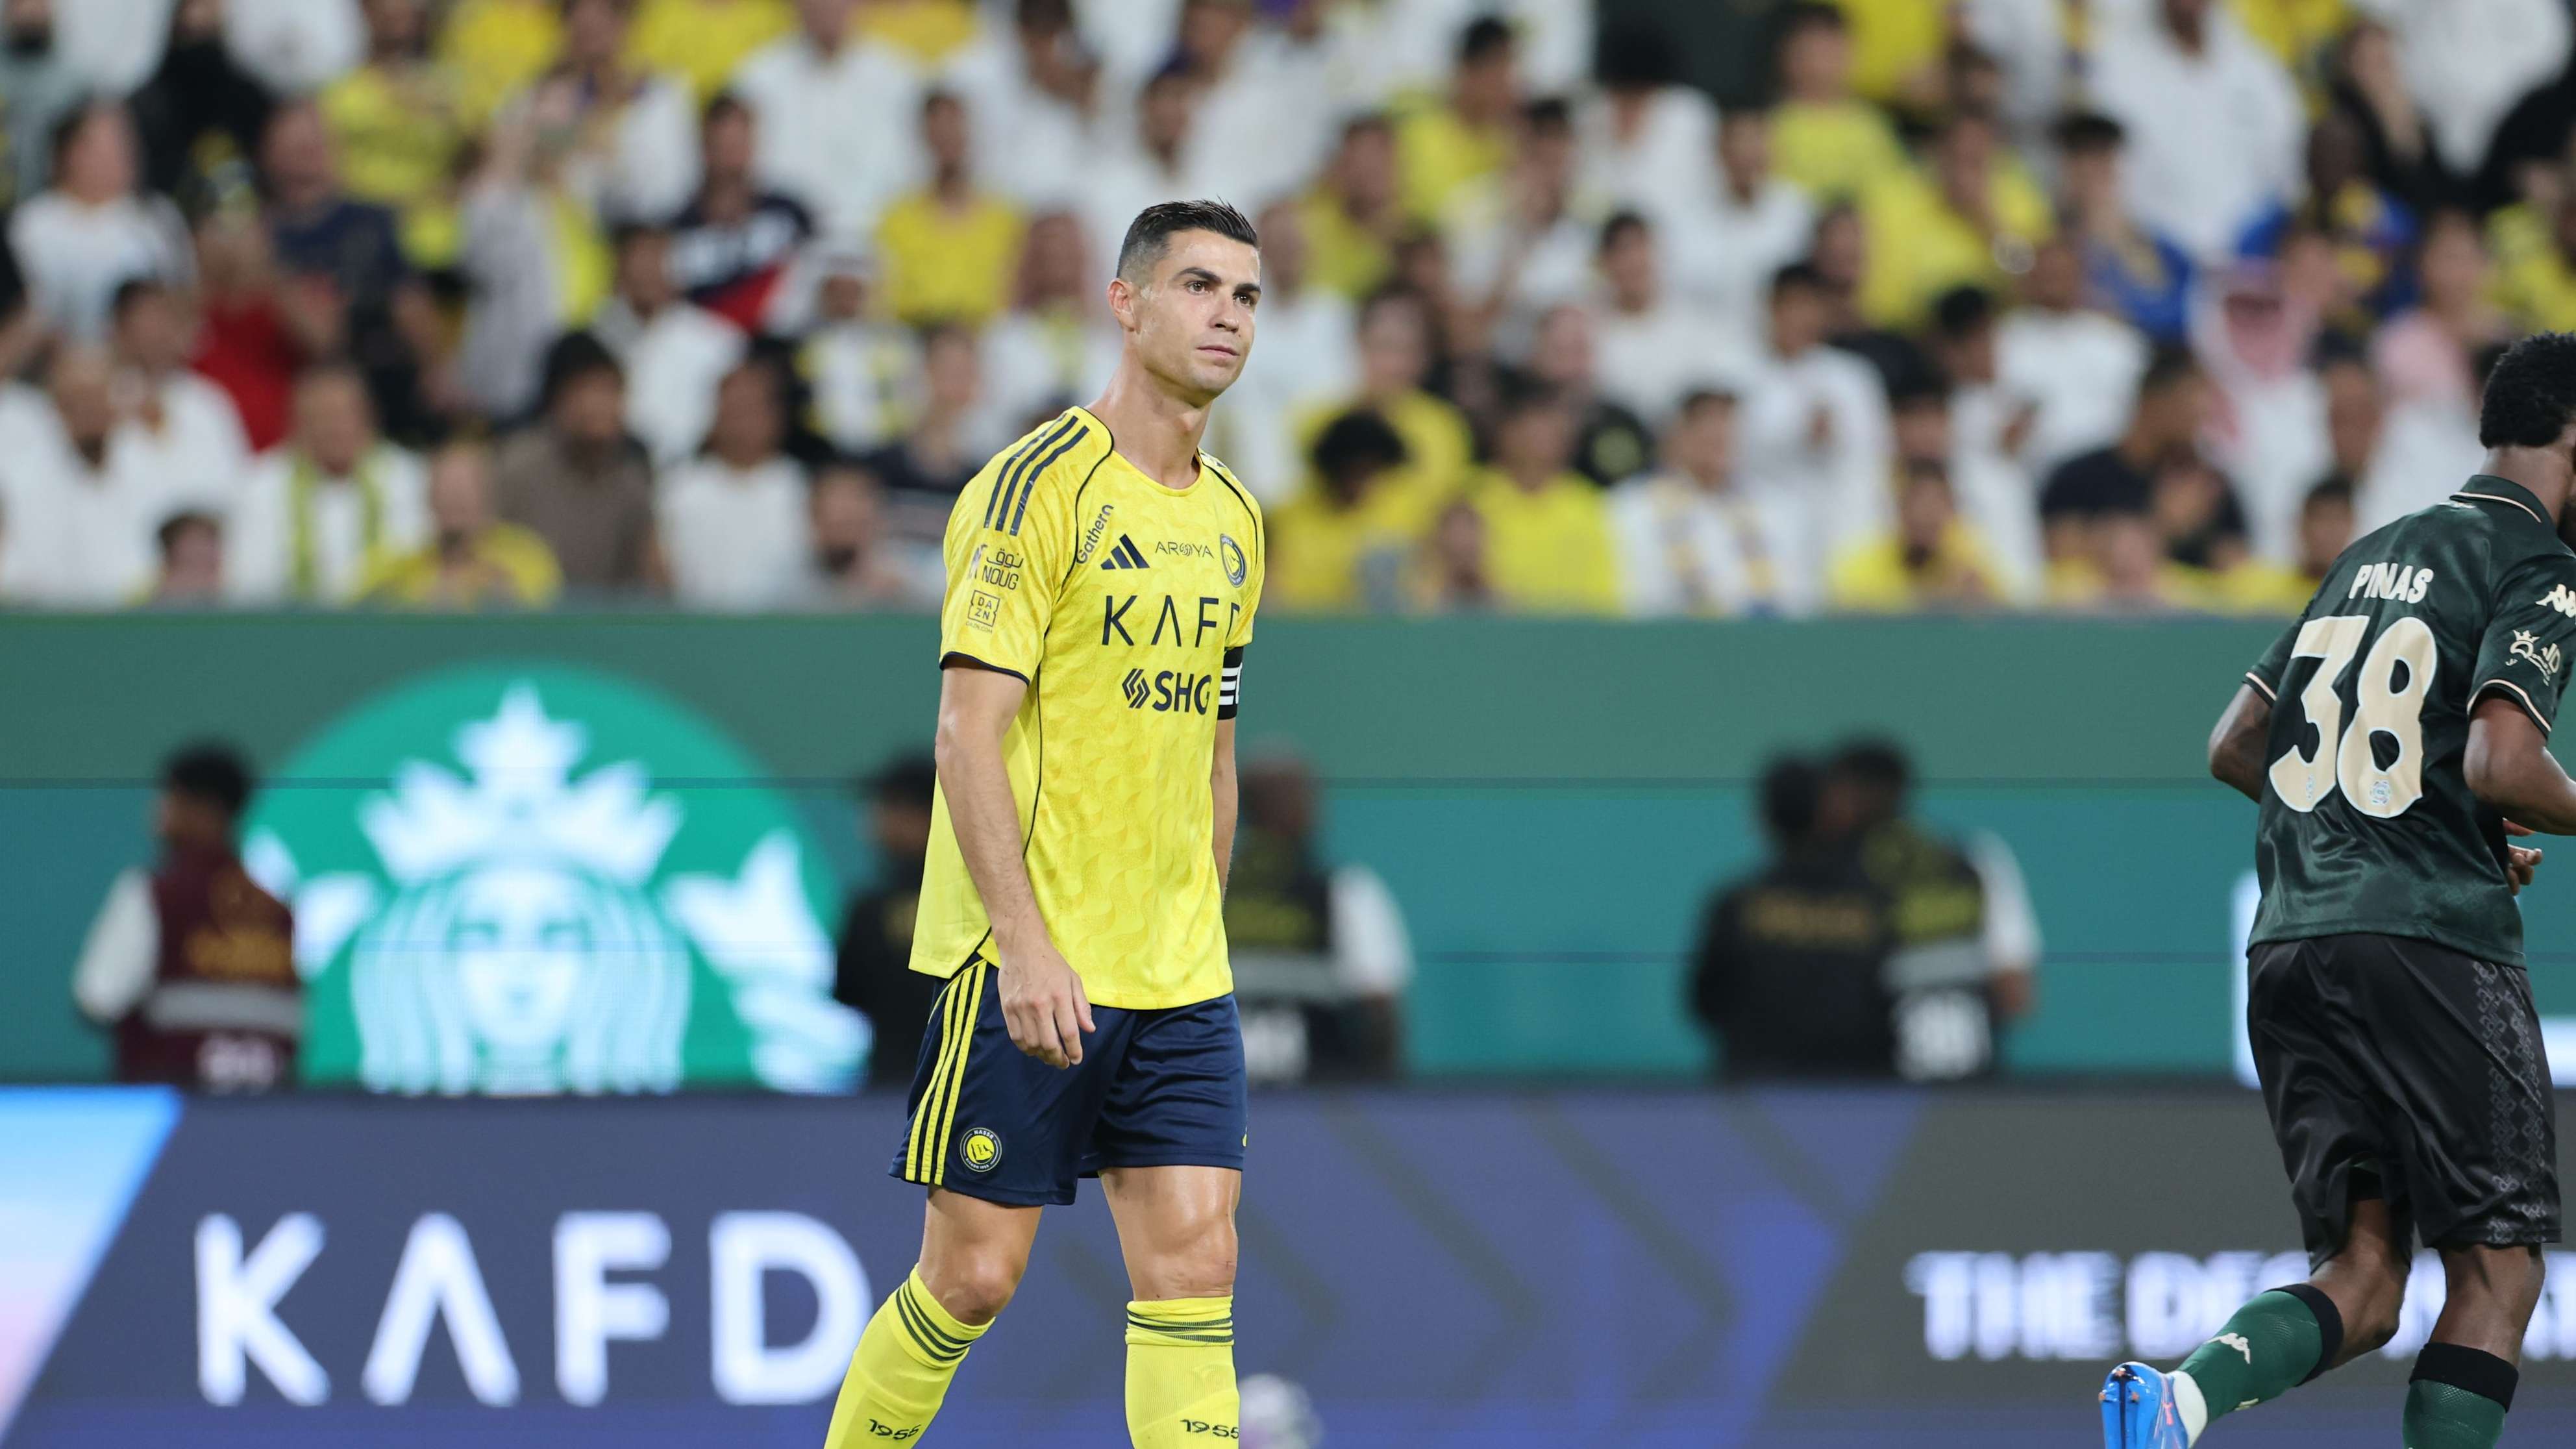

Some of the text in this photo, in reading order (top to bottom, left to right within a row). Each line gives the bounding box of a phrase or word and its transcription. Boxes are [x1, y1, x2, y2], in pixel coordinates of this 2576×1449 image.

[1076, 504, 1114, 564] Gathern
[982, 565, 1019, 590] NOUG
[2348, 562, 2434, 604] PINAS
[1152, 671, 1212, 715] SHG
[2268, 615, 2437, 819] 38
[193, 1210, 873, 1407] KAFD
[1905, 1250, 2124, 1361] THE
[869, 1418, 921, 1440] 1955
[1180, 1419, 1239, 1439] 1955
